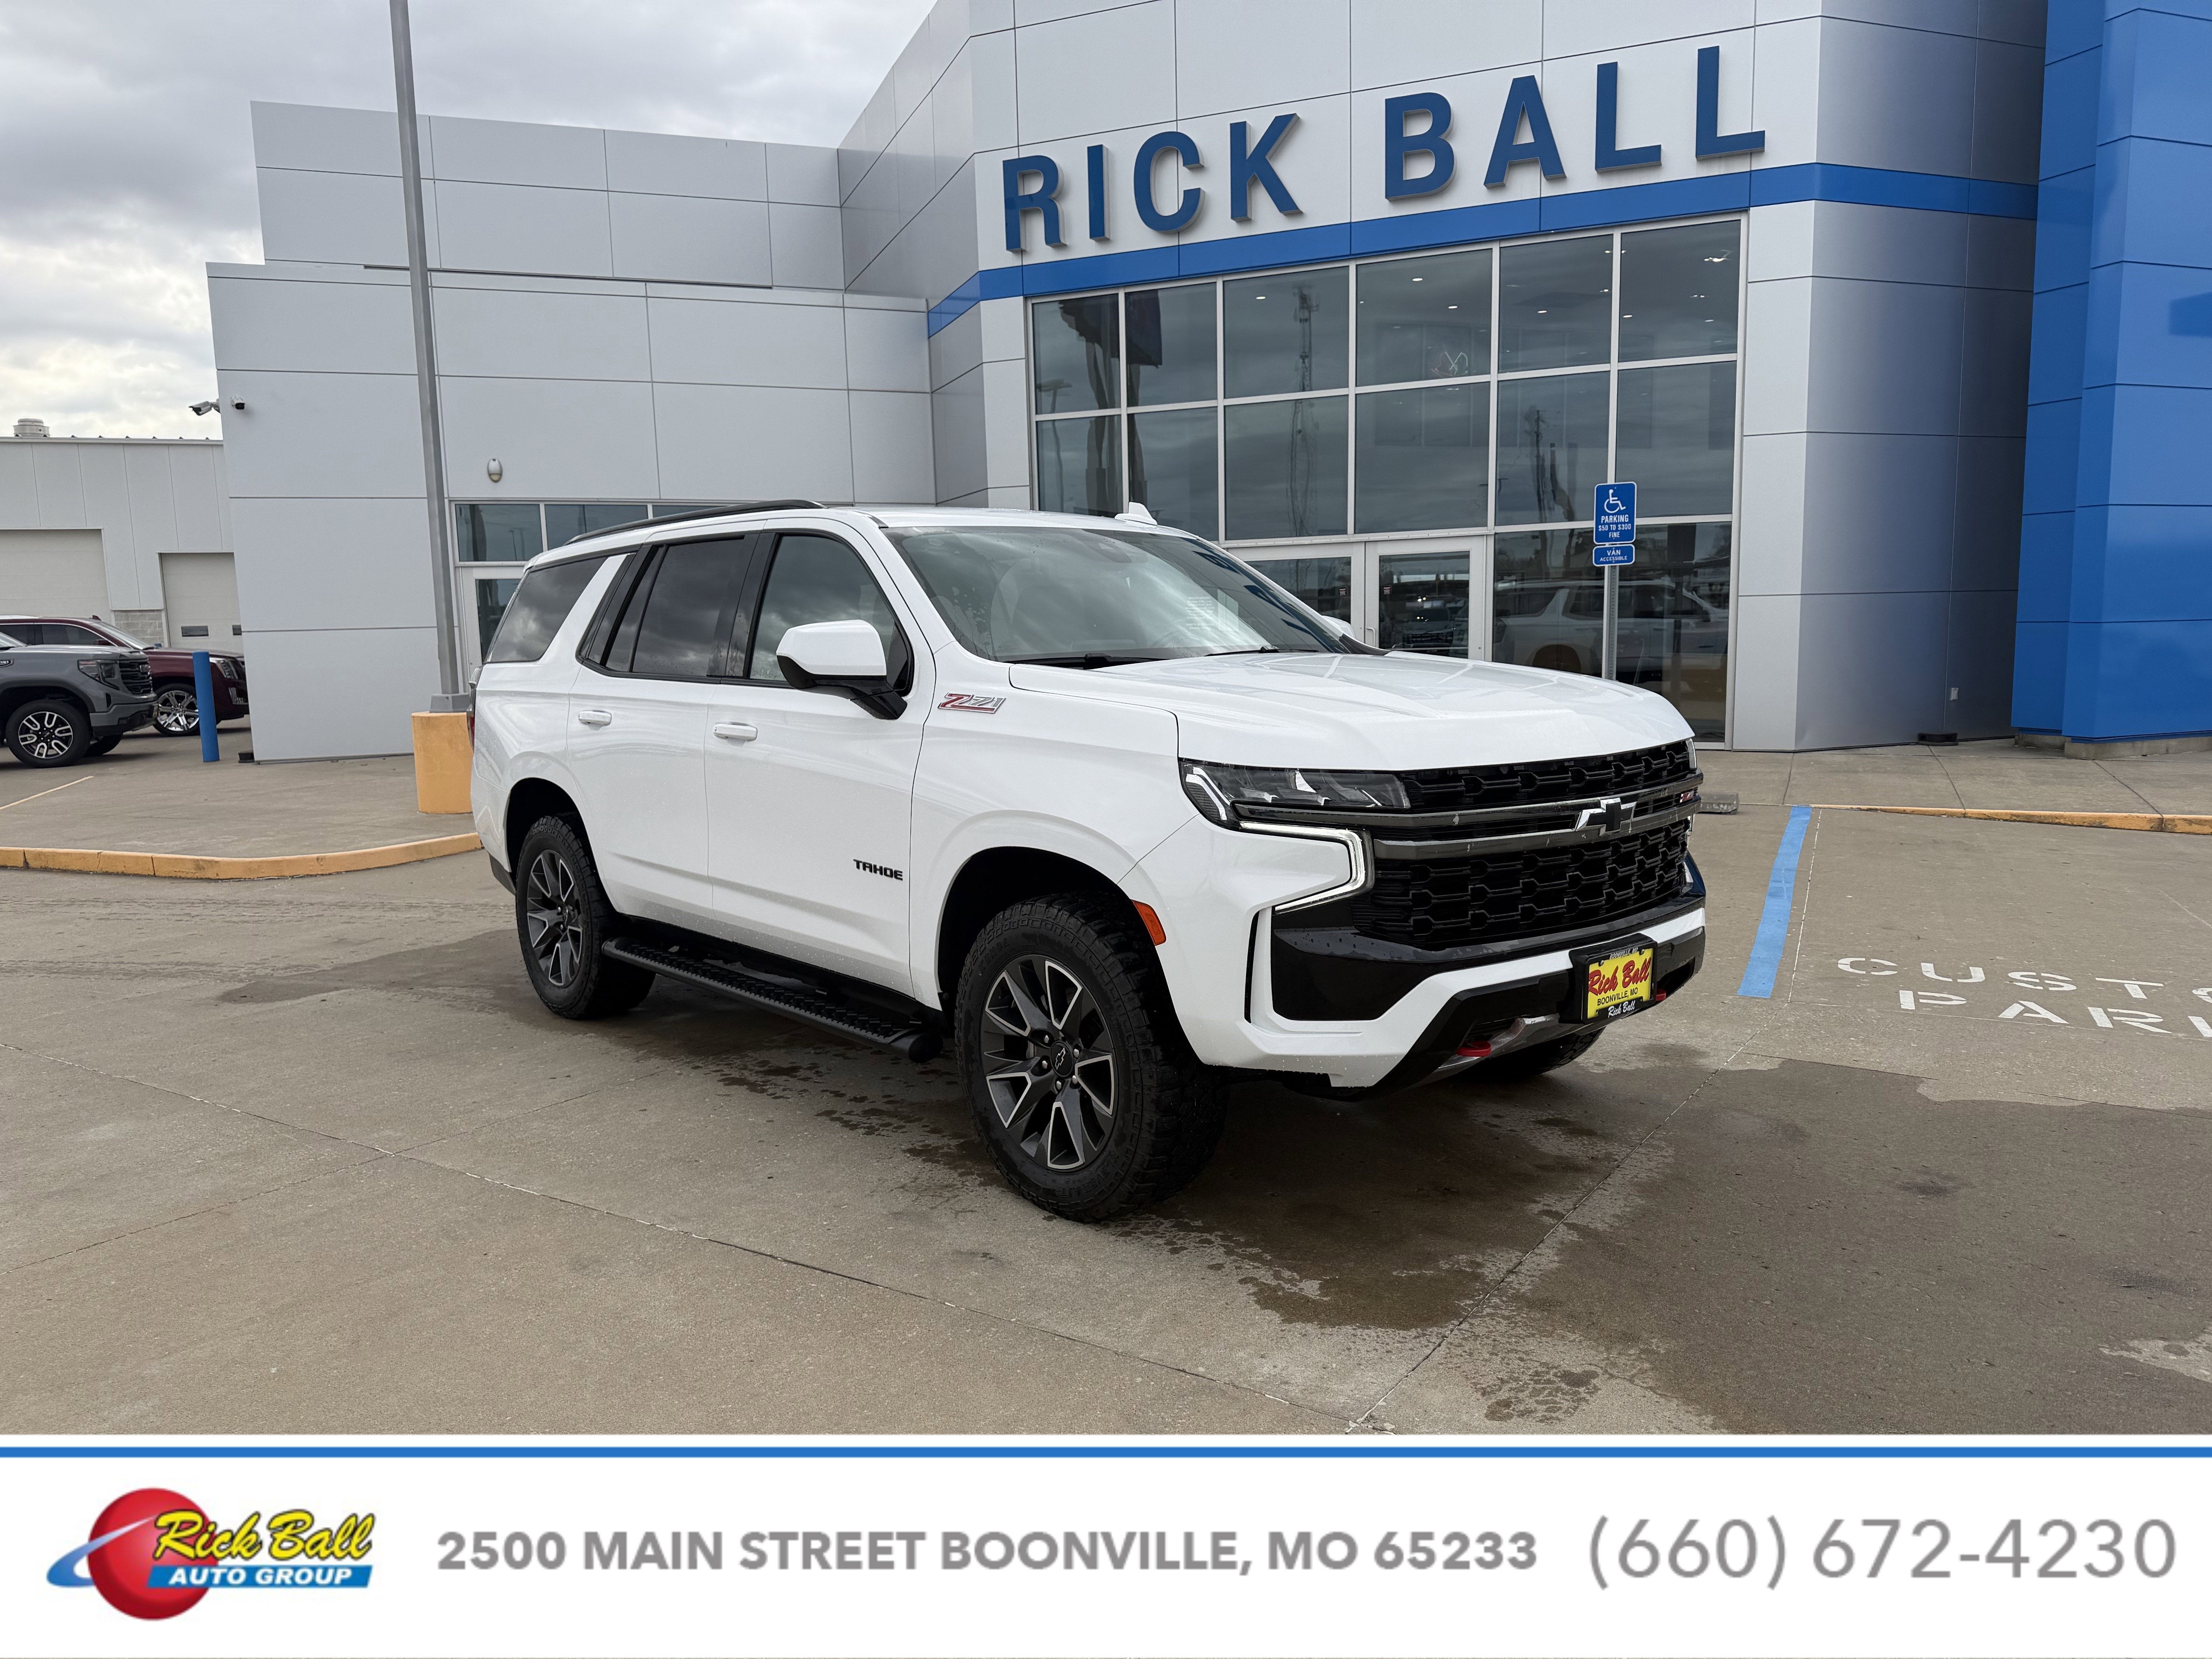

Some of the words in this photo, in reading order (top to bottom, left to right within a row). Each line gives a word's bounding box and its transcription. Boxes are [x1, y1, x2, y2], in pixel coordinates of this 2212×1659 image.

[1002, 113, 1303, 252] RICK
[1385, 46, 1765, 201] BALL
[1601, 514, 1629, 524] PARKING
[937, 692, 1006, 714] Z71
[853, 859, 903, 881] TAHOE
[1588, 965, 1619, 996] Rick
[1622, 957, 1651, 988] Ball
[1597, 991, 1629, 1006] BOONVILLE,
[1630, 988, 1638, 996] MO
[1608, 1003, 1621, 1018] Rick
[1623, 1000, 1635, 1013] Ball
